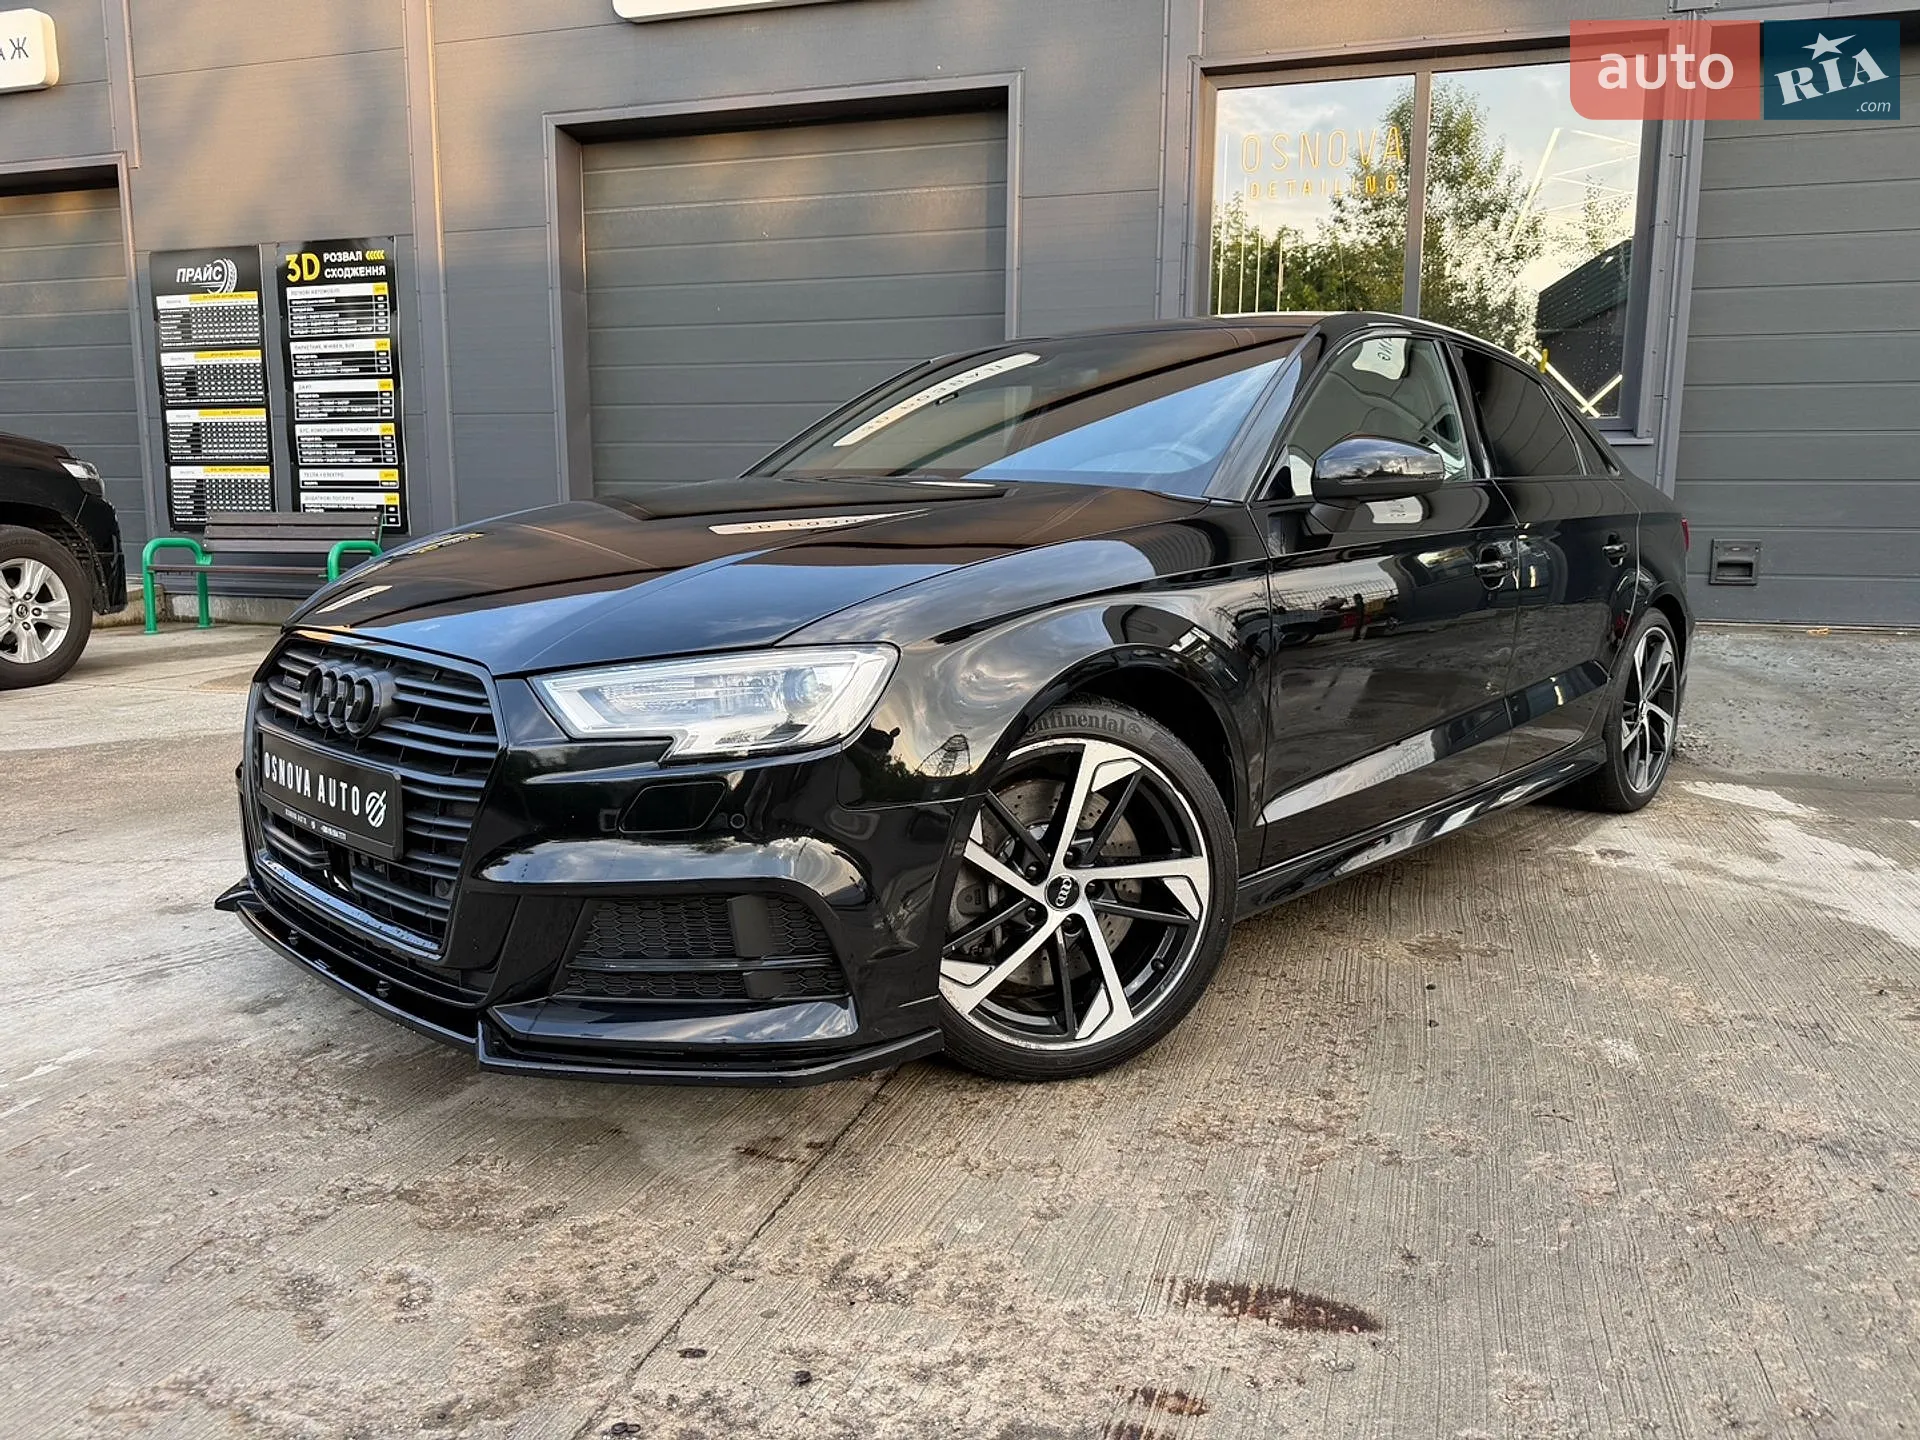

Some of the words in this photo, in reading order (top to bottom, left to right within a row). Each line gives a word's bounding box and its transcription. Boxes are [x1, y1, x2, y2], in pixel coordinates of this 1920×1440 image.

[1241, 126, 1404, 174] OSNOVA
[1249, 174, 1398, 200] DETAILING
[176, 264, 223, 283] ПРАЙС
[285, 252, 321, 282] 3D
[323, 251, 363, 263] РОЗВАЛ
[324, 265, 387, 279] СХОДЖЕННЯ
[1026, 711, 1125, 736] ontinental
[264, 751, 311, 798] OSNOVA
[317, 774, 360, 816] AUTO
